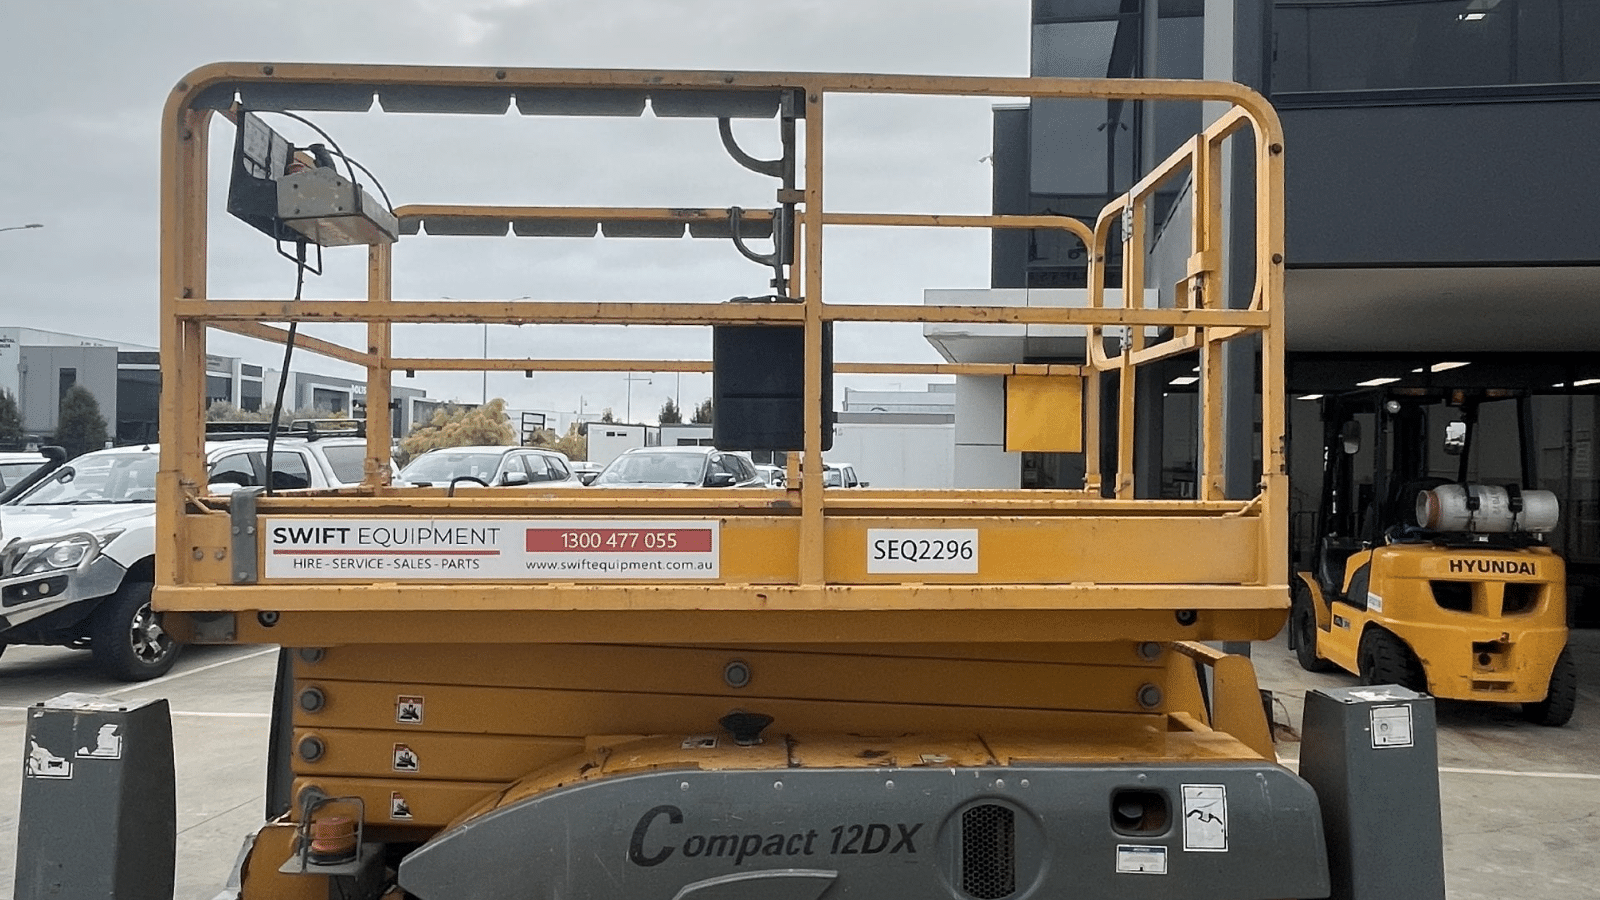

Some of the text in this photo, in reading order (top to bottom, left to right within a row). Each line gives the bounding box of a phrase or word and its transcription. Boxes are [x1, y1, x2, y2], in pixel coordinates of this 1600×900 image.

[273, 527, 501, 548] SWIFT EQUIPMENT
[560, 532, 678, 548] 1300 477 055
[874, 539, 973, 562] SEQ2296
[293, 558, 480, 570] HIRE SERVICE SALES PARTS
[525, 559, 713, 573] www.swiftequipment.com.au
[1449, 559, 1536, 576] HYUNDAI
[628, 804, 923, 867] Compact 12DX
